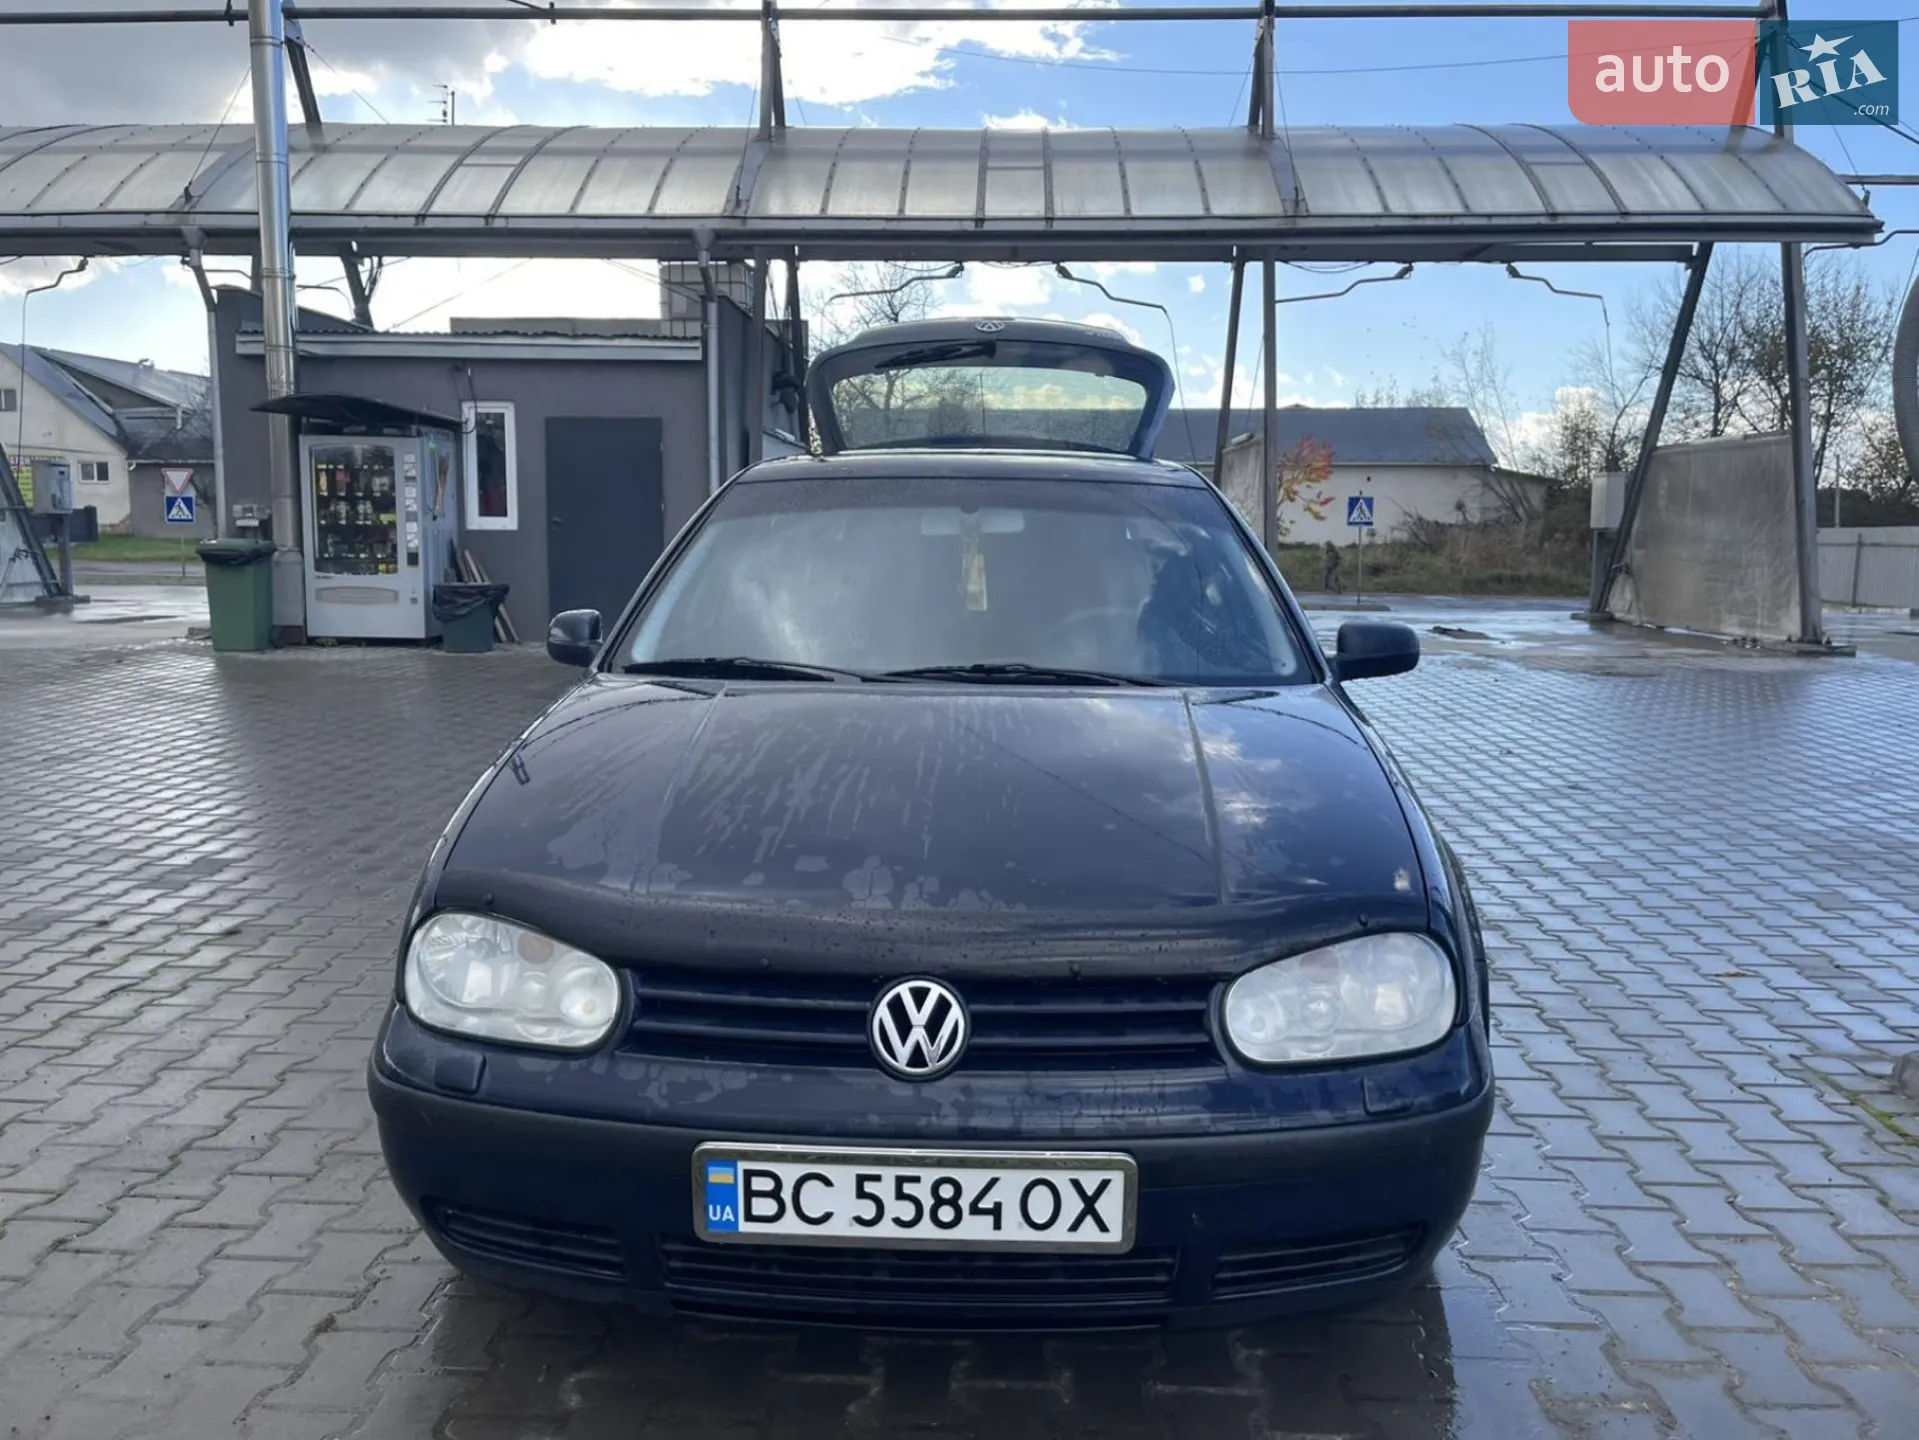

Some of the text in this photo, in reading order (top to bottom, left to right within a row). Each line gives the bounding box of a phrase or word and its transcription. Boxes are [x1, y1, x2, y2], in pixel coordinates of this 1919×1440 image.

[708, 1204, 735, 1222] UA
[743, 1168, 1113, 1233] BC 5584 OX
